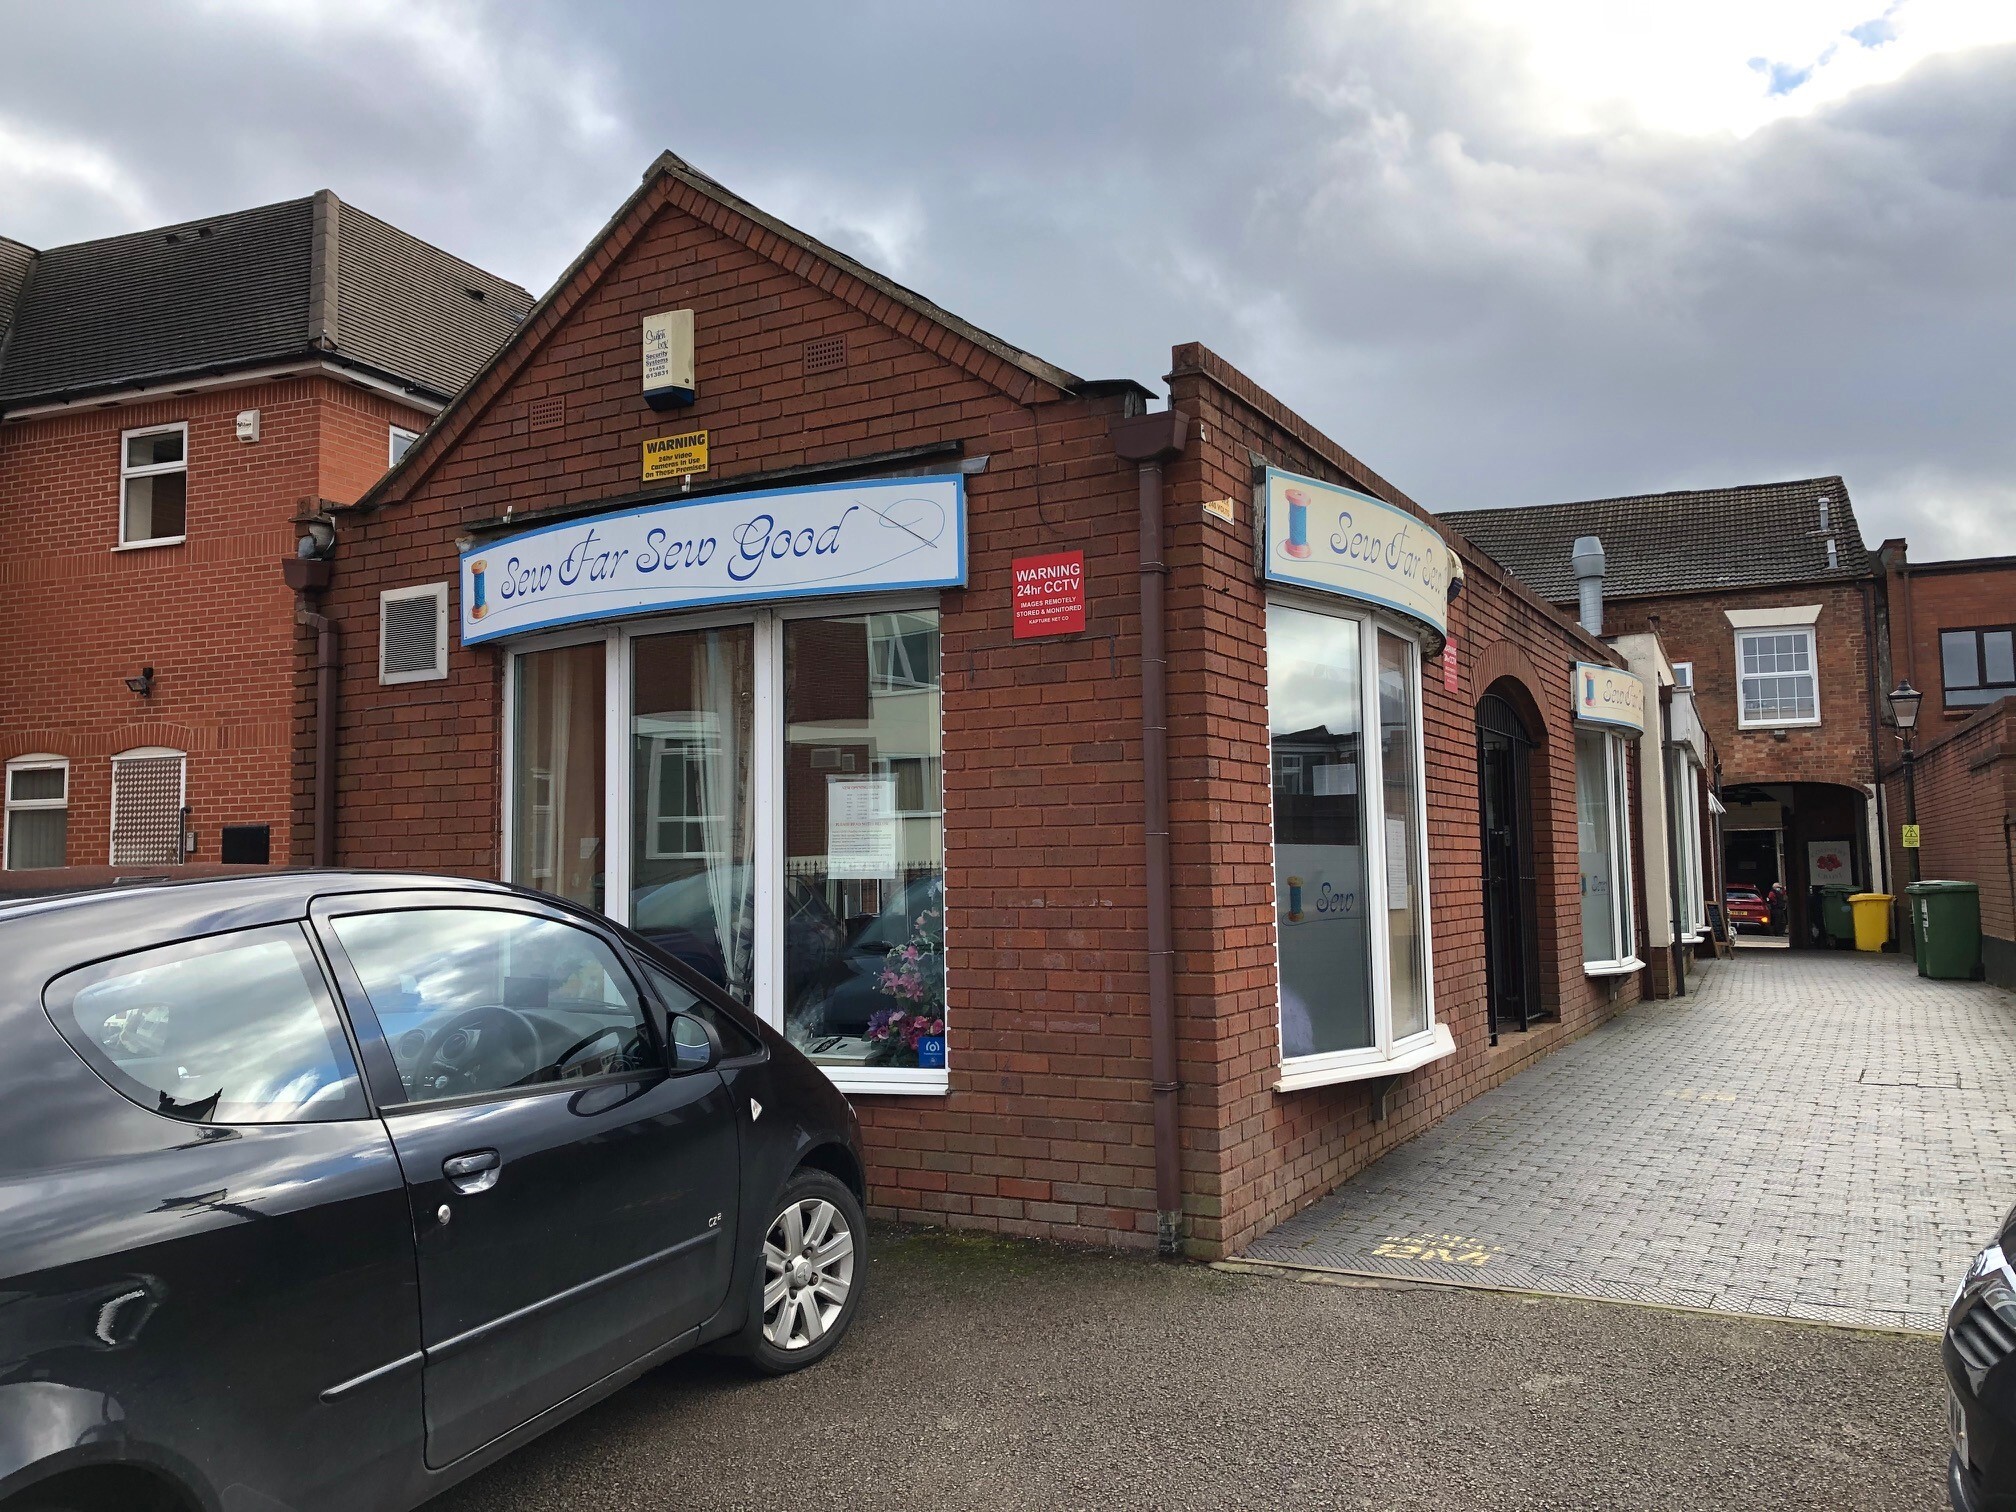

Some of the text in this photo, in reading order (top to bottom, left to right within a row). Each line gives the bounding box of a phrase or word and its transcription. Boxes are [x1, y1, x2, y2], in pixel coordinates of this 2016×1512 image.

[645, 351, 668, 360] Security
[645, 358, 669, 367] Systems
[647, 433, 706, 454] WARNING
[658, 452, 693, 463] 24hr Video
[651, 461, 679, 471] Cameras
[656, 469, 675, 477] These
[675, 464, 706, 473] Premises
[500, 505, 860, 600] Sew Far Sew Good
[1329, 511, 1382, 564] Sew
[1385, 524, 1422, 580] Far
[1016, 563, 1080, 582] WARNING
[1017, 578, 1080, 597] 24hr CCTV
[1020, 596, 1076, 608] IMAGES REMOTELY
[1016, 609, 1040, 618] STORED
[1046, 604, 1082, 614] MONITORED
[1316, 881, 1355, 913] Sew
